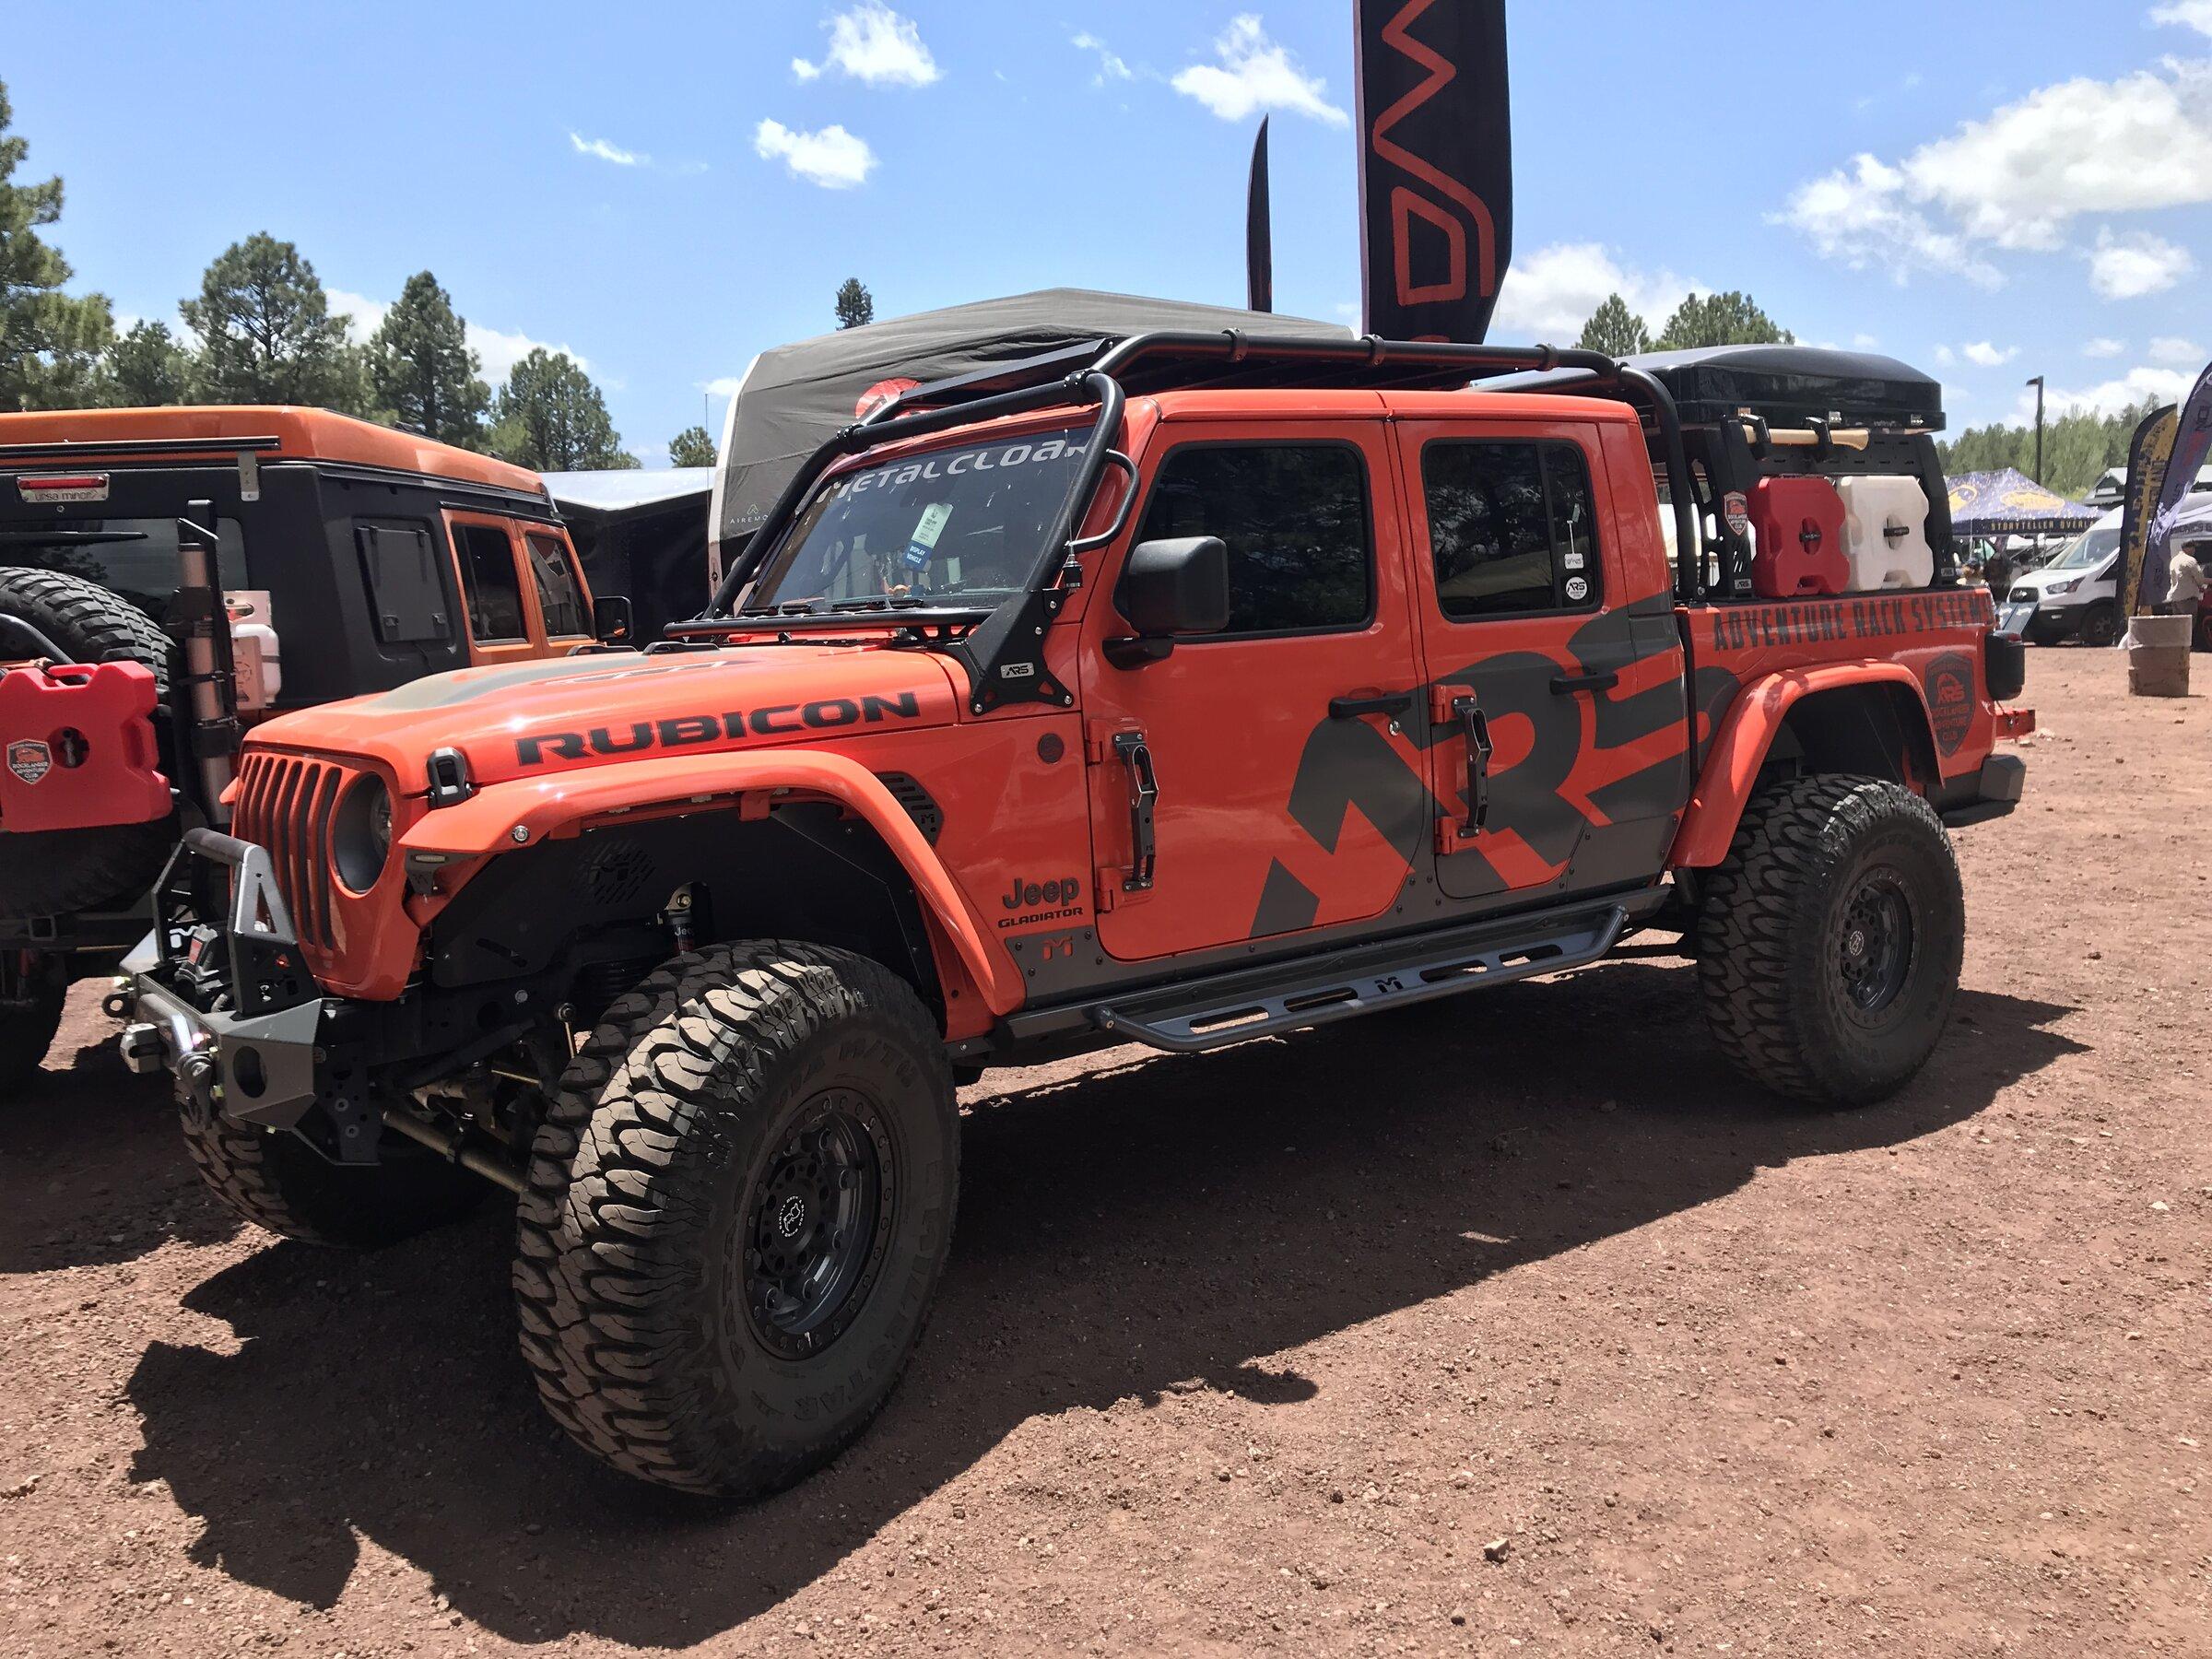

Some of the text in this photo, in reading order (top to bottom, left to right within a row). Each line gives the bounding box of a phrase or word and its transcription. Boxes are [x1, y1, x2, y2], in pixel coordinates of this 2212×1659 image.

[34, 490, 91, 501] ursa minor
[729, 514, 769, 524] AIREMO
[1991, 519, 2095, 532] STORYTELLER OVERLA
[906, 552, 923, 564] VEHICLE
[1567, 582, 1585, 593] ARS
[1713, 593, 1994, 652] ADVENTURE RACK SYSTEMS
[1006, 665, 1030, 677] ARS
[517, 691, 921, 767] RUBICON
[1002, 877, 1080, 910] Jeep
[998, 906, 1084, 929] GLADIATOR
